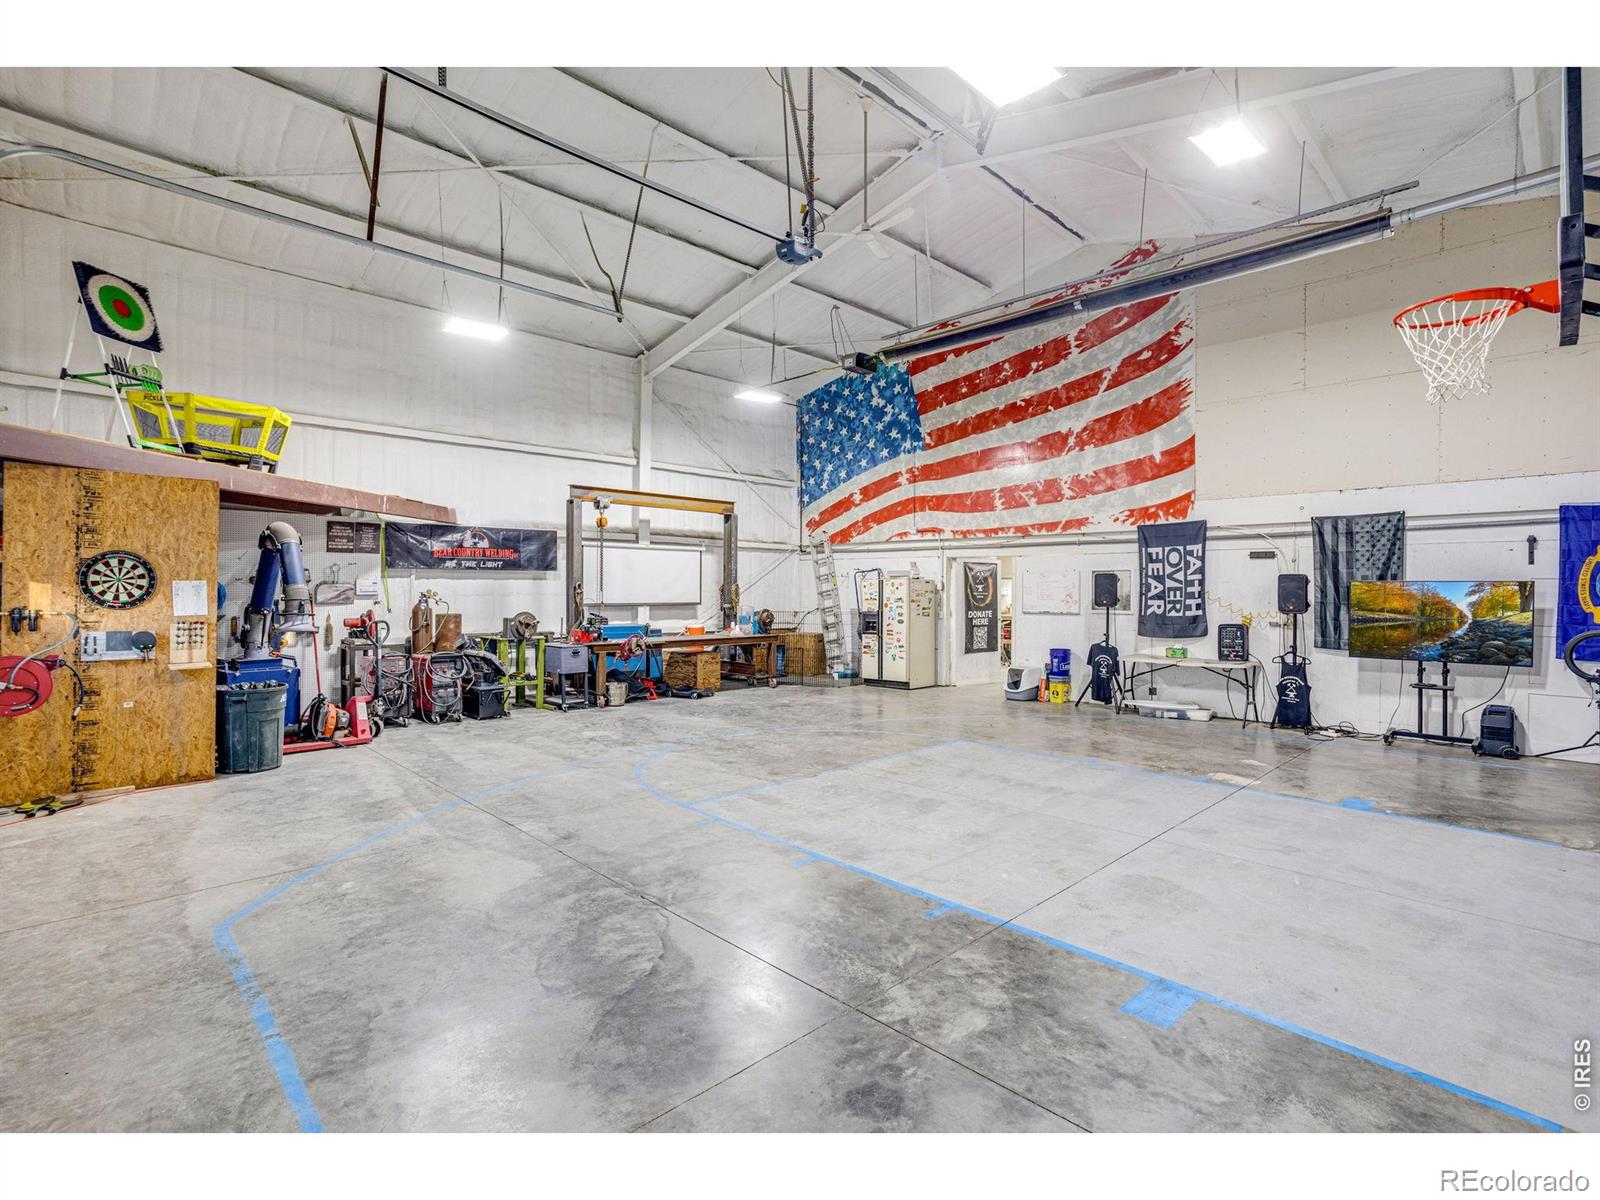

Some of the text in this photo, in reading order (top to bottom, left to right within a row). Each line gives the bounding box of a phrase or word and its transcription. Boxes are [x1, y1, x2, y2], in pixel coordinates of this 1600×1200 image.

[433, 547, 452, 557] BEAR
[453, 548, 483, 558] COUNTRY
[485, 549, 514, 559] WELDING
[461, 560, 477, 568] THE
[1582, 558, 1593, 577] UNITED
[1146, 547, 1165, 616] FEAR
[1166, 547, 1183, 614] OVER
[1185, 543, 1203, 616] FAITH
[1582, 596, 1591, 610] NAVY
[968, 610, 993, 618] DONATE
